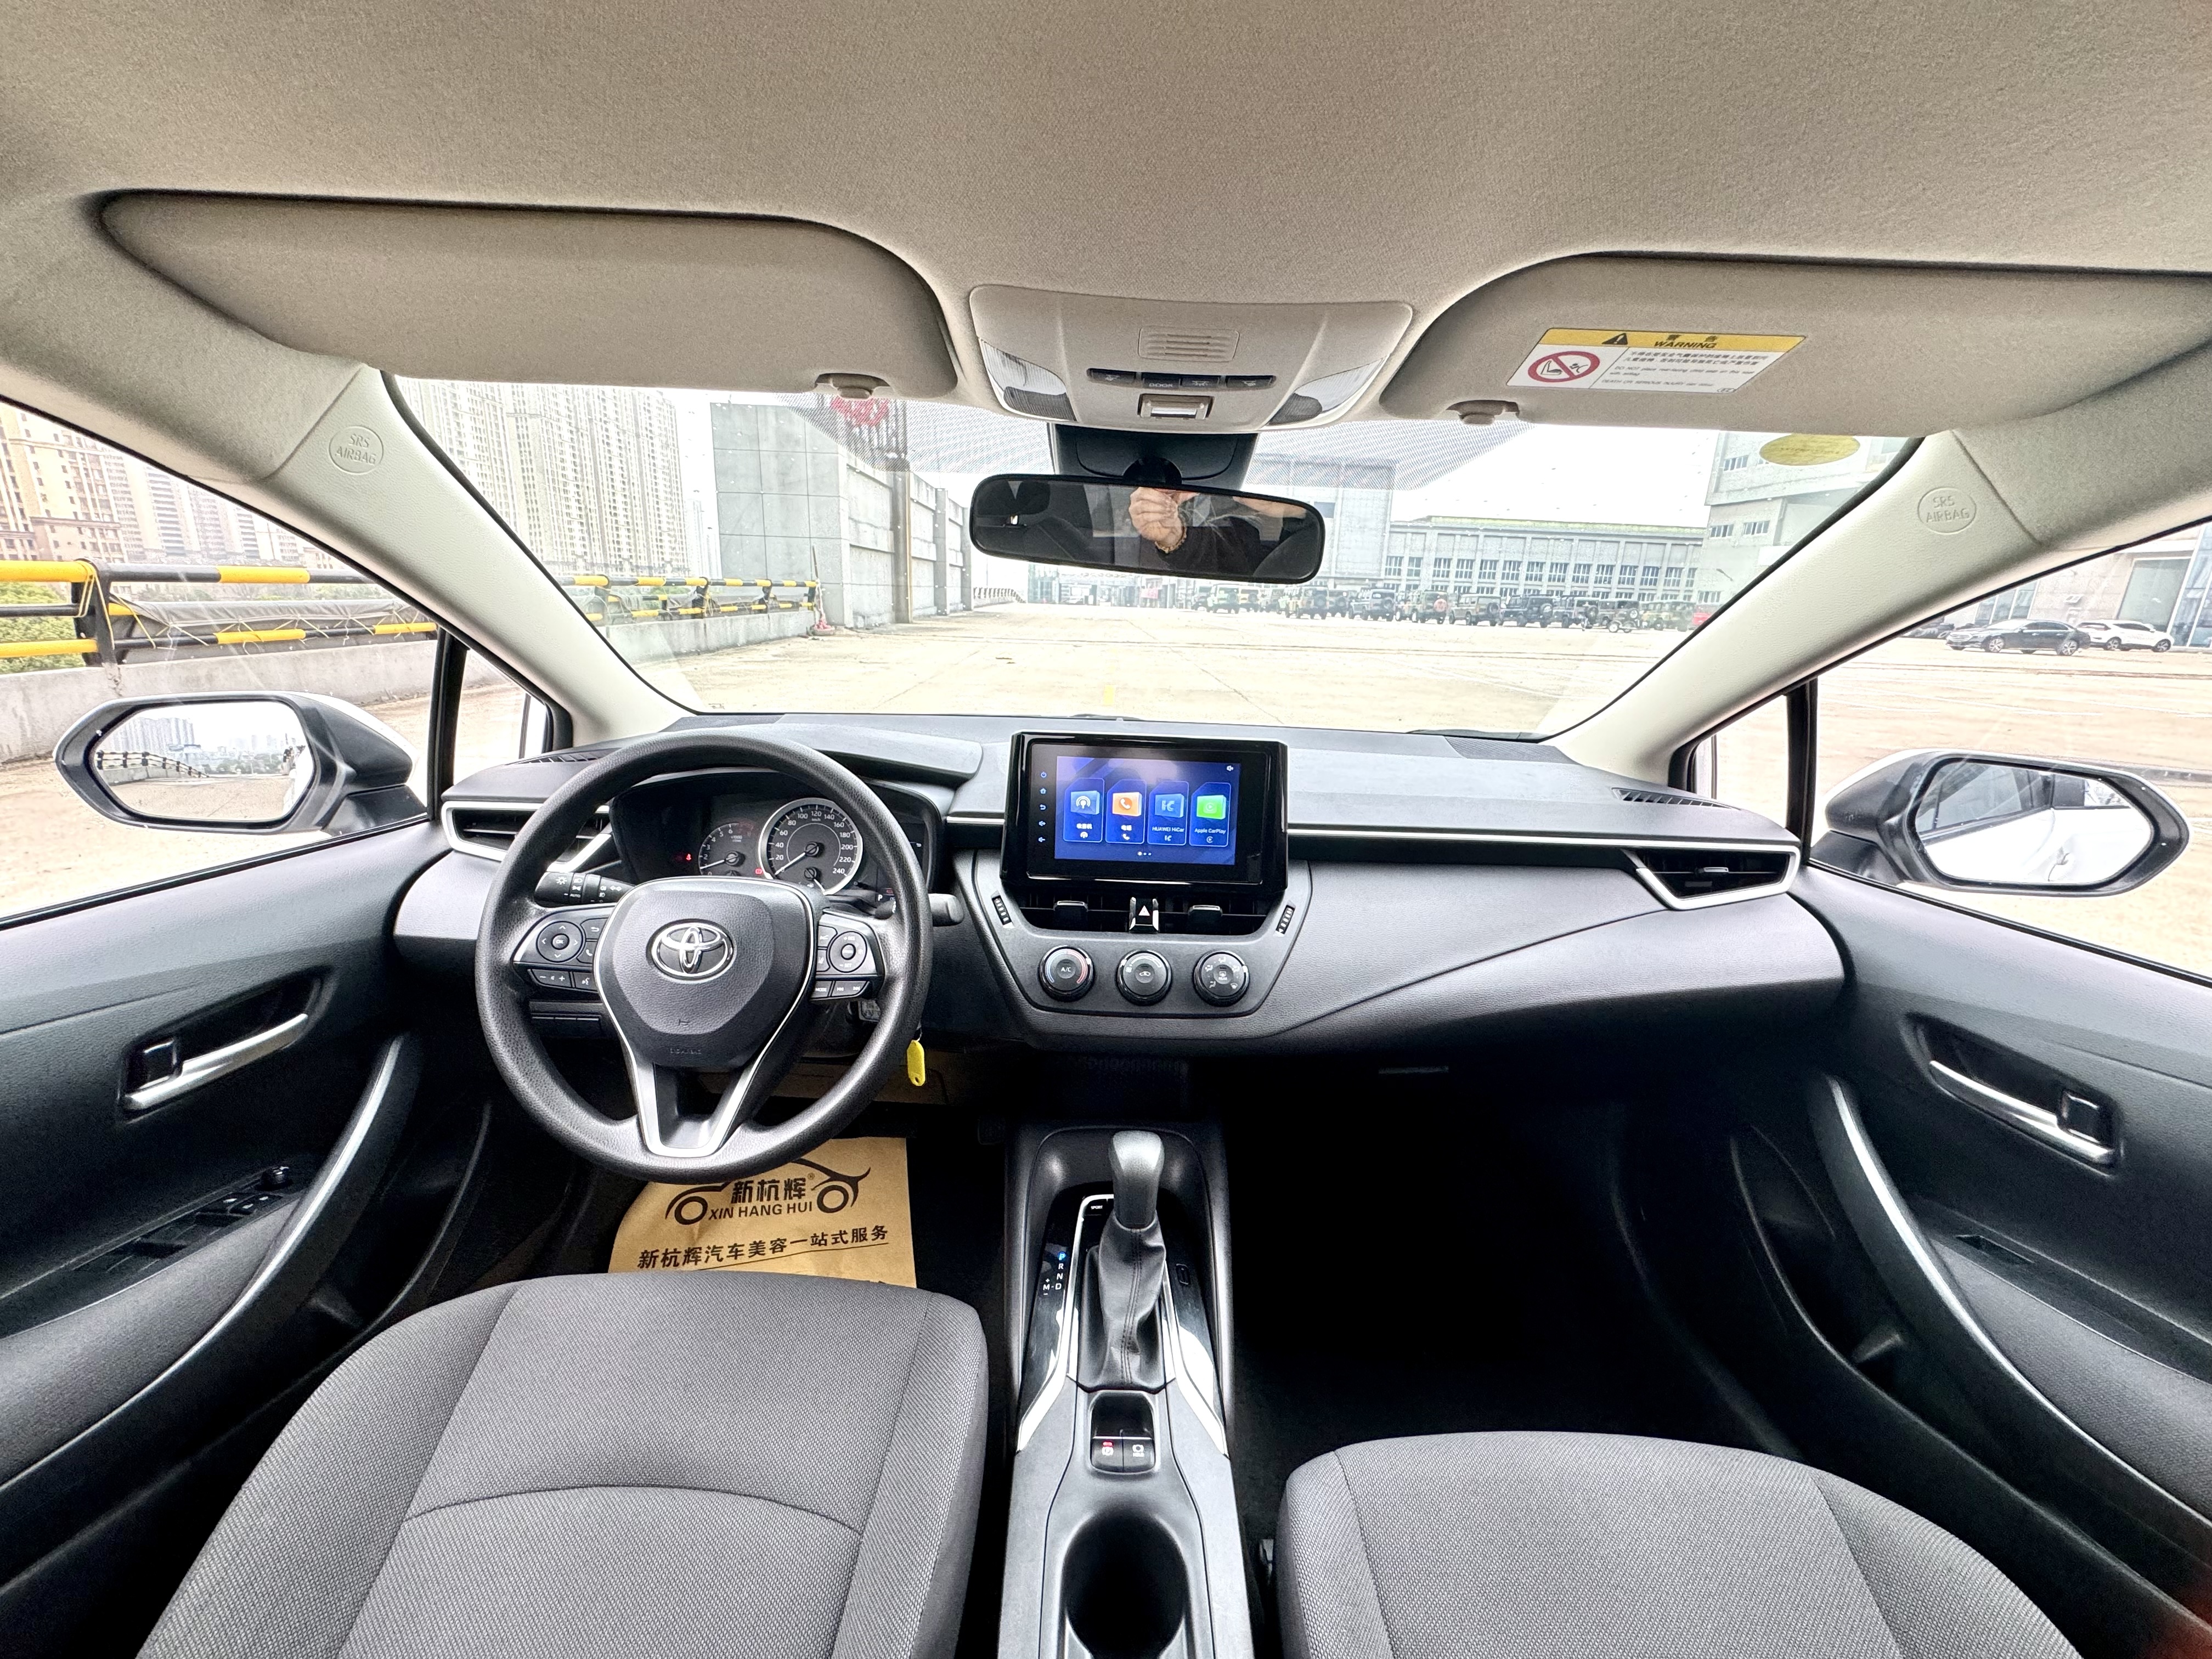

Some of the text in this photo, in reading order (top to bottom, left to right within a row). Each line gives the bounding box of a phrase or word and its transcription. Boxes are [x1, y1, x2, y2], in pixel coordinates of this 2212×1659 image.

[348, 433, 370, 448] SRS
[335, 446, 377, 466] AIRBAG
[1932, 495, 1955, 508] SRS
[1926, 508, 1970, 523] AIRBAG
[730, 1178, 806, 1204] 新杭辉
[709, 1201, 812, 1221] XIN HANG HUI
[637, 1224, 888, 1269] 新杭辉汽车美容一站式服务
